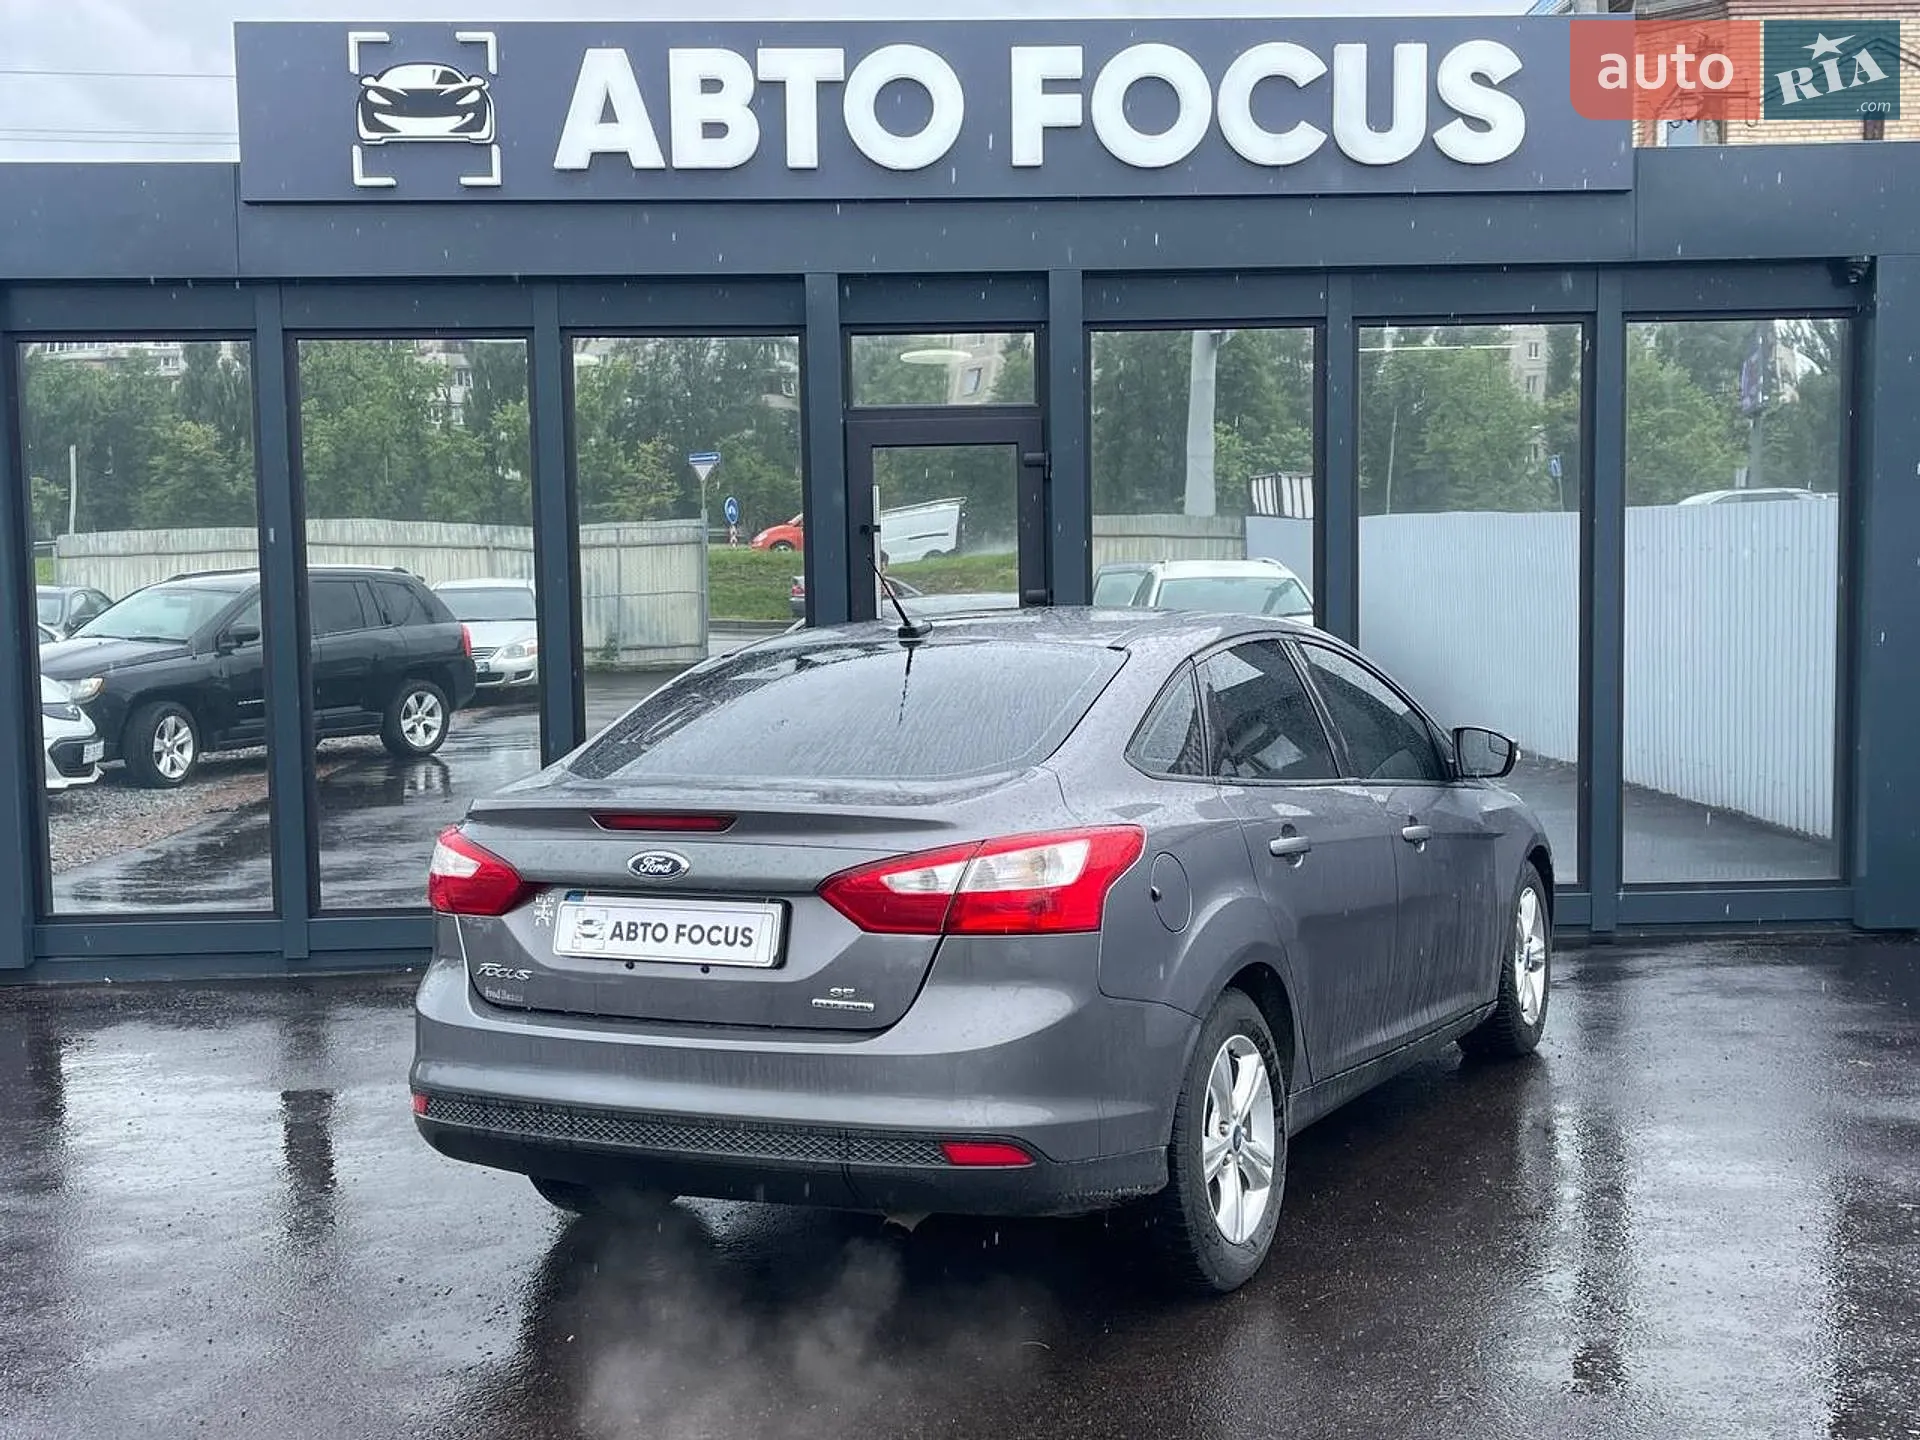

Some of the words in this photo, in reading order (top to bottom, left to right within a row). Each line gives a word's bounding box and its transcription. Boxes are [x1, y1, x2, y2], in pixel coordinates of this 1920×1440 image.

[553, 43, 965, 170] АВТО
[1010, 38, 1527, 168] FOCUS
[639, 856, 673, 873] Ford
[609, 921, 669, 943] АВТО
[674, 923, 754, 948] FOCUS
